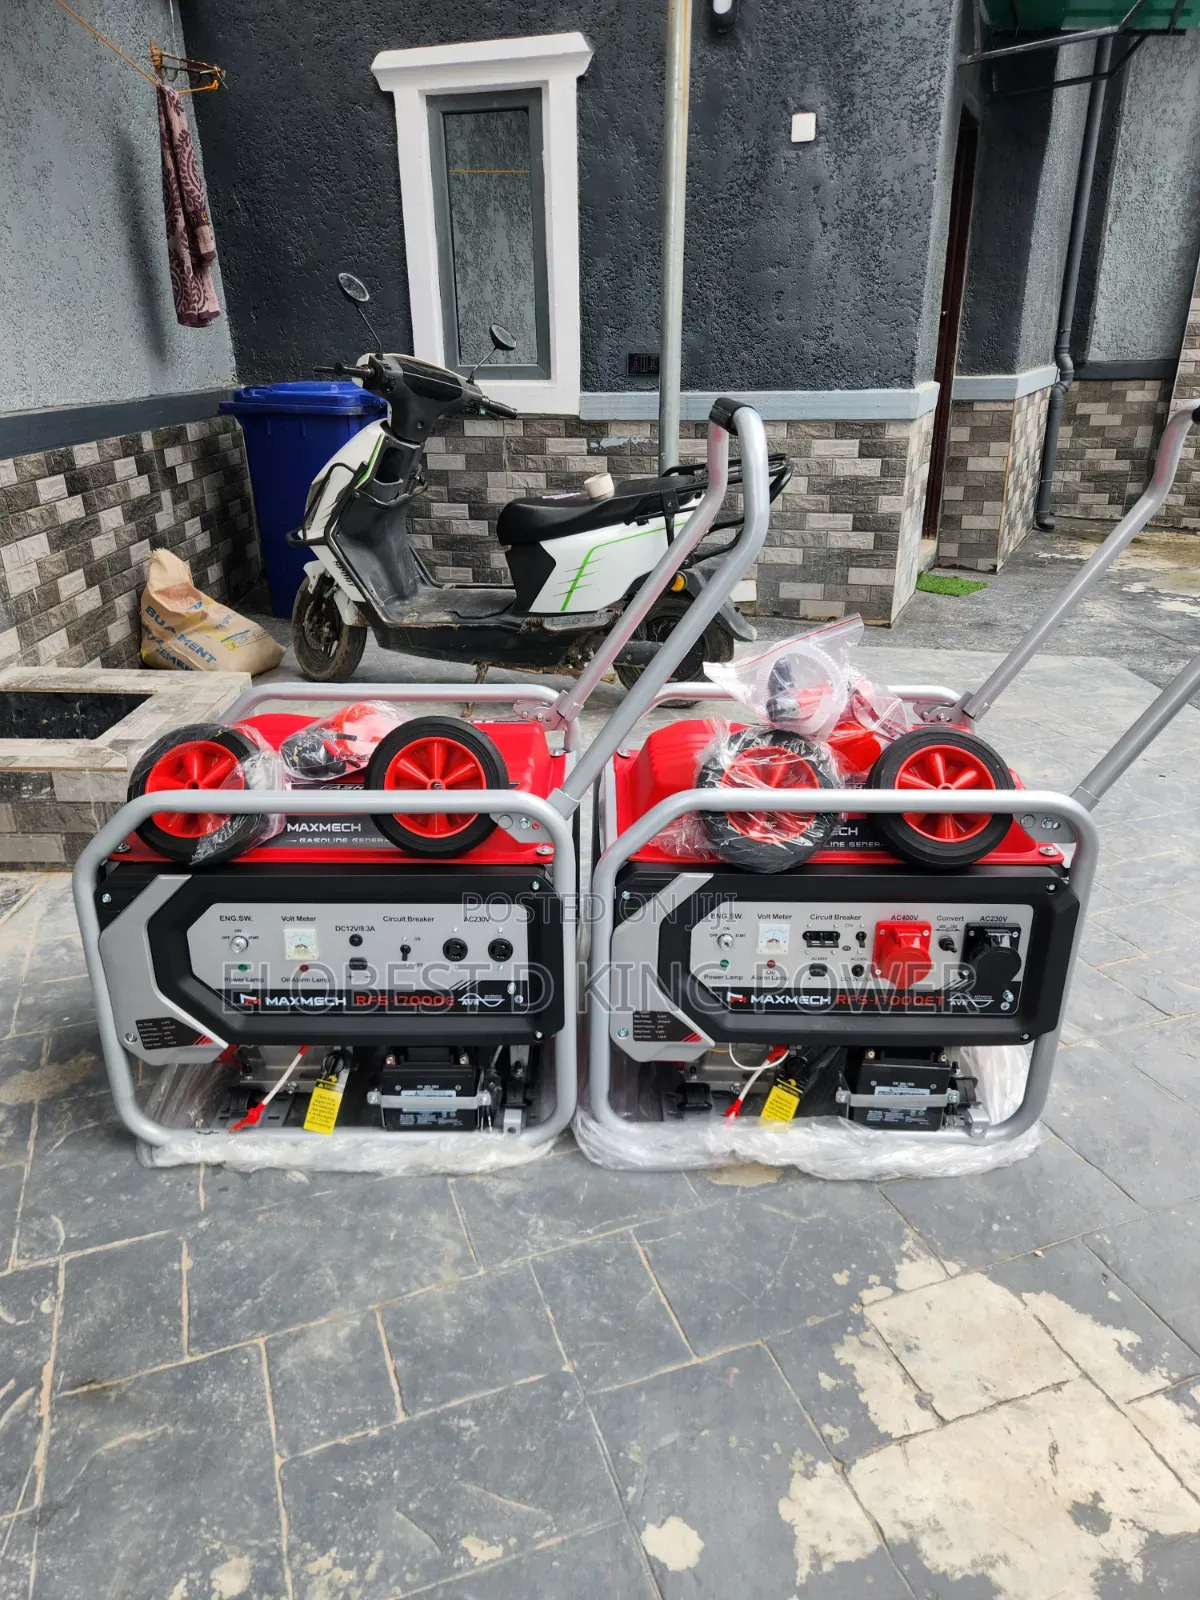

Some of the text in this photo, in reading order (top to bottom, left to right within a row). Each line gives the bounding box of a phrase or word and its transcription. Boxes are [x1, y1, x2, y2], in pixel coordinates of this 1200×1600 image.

[177, 633, 217, 664] MENT
[287, 823, 362, 832] MAXMECH
[265, 996, 346, 1006] MAXMECH
[750, 995, 831, 1005] MAXMECH
